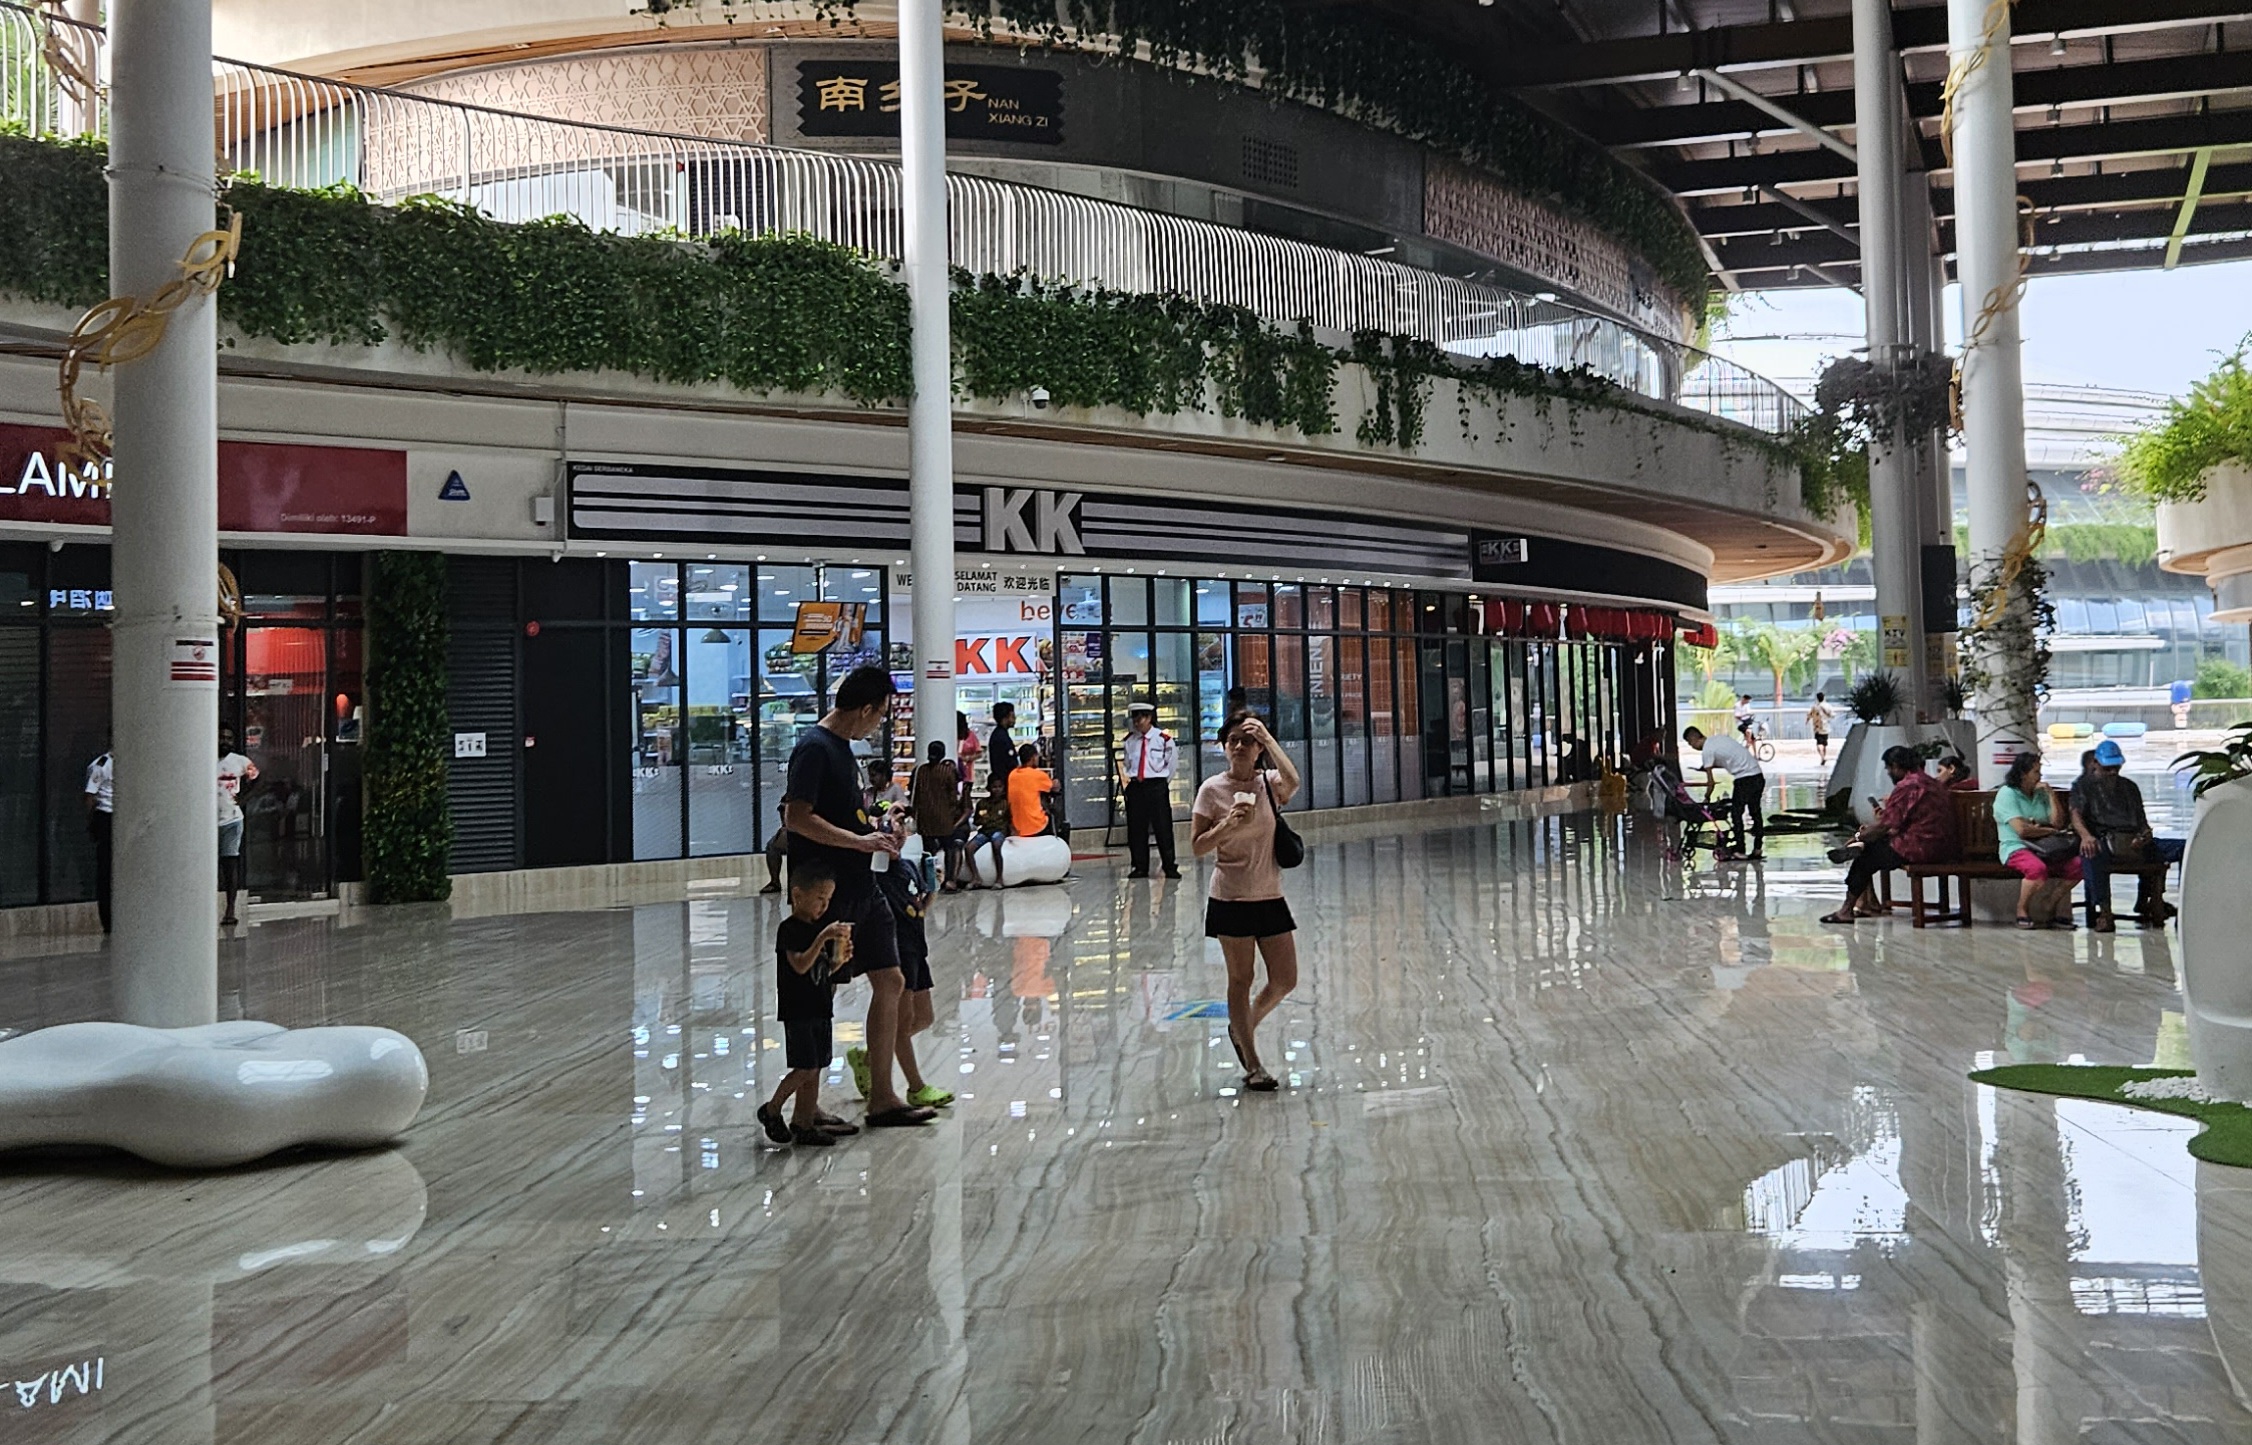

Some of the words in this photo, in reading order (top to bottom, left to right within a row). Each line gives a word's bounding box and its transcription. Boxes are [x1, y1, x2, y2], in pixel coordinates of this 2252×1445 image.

[988, 98, 1019, 109] NAN
[989, 113, 1032, 126] XIANG
[1036, 115, 1048, 127] ZI
[984, 487, 1086, 554] KK
[954, 571, 997, 581] SELAMAT
[1003, 576, 1050, 590] 欢迎光临
[957, 582, 996, 592] DATANG
[955, 636, 1032, 674] KK
